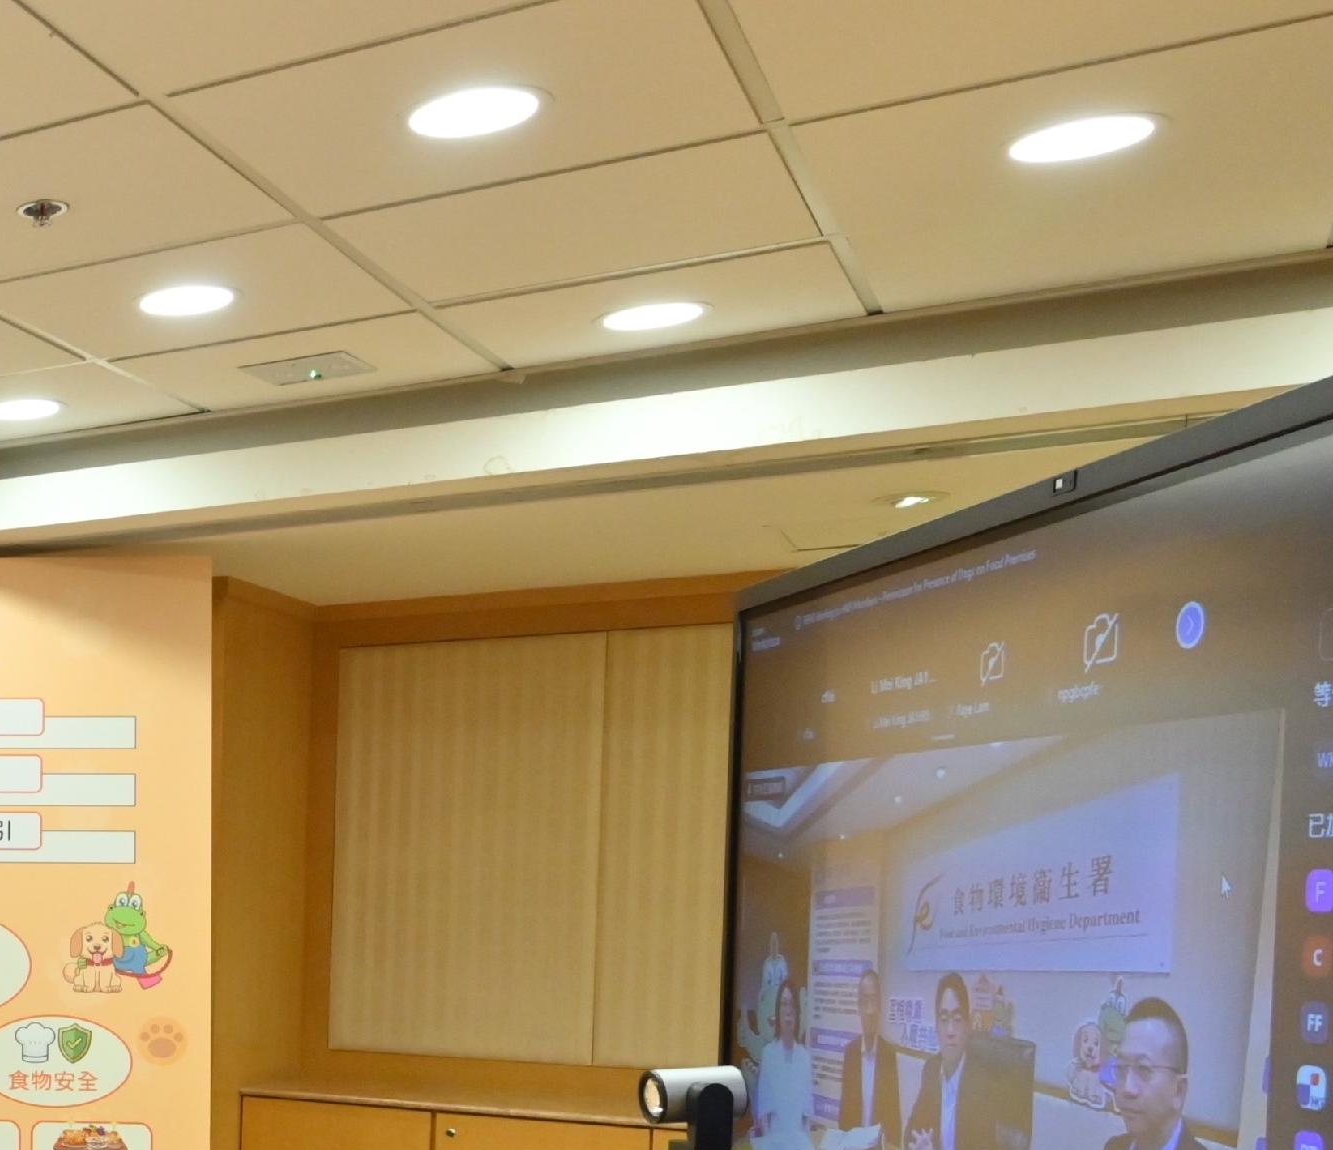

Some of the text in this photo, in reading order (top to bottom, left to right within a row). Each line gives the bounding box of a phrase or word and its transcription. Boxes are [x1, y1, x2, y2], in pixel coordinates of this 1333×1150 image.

[1313, 681, 1333, 708] 等
[1027, 915, 1067, 935] Hygiene
[1070, 908, 1141, 932] Department
[1313, 948, 1323, 967] C
[1306, 1013, 1323, 1032] FF
[9, 1070, 98, 1093] 食物安全
